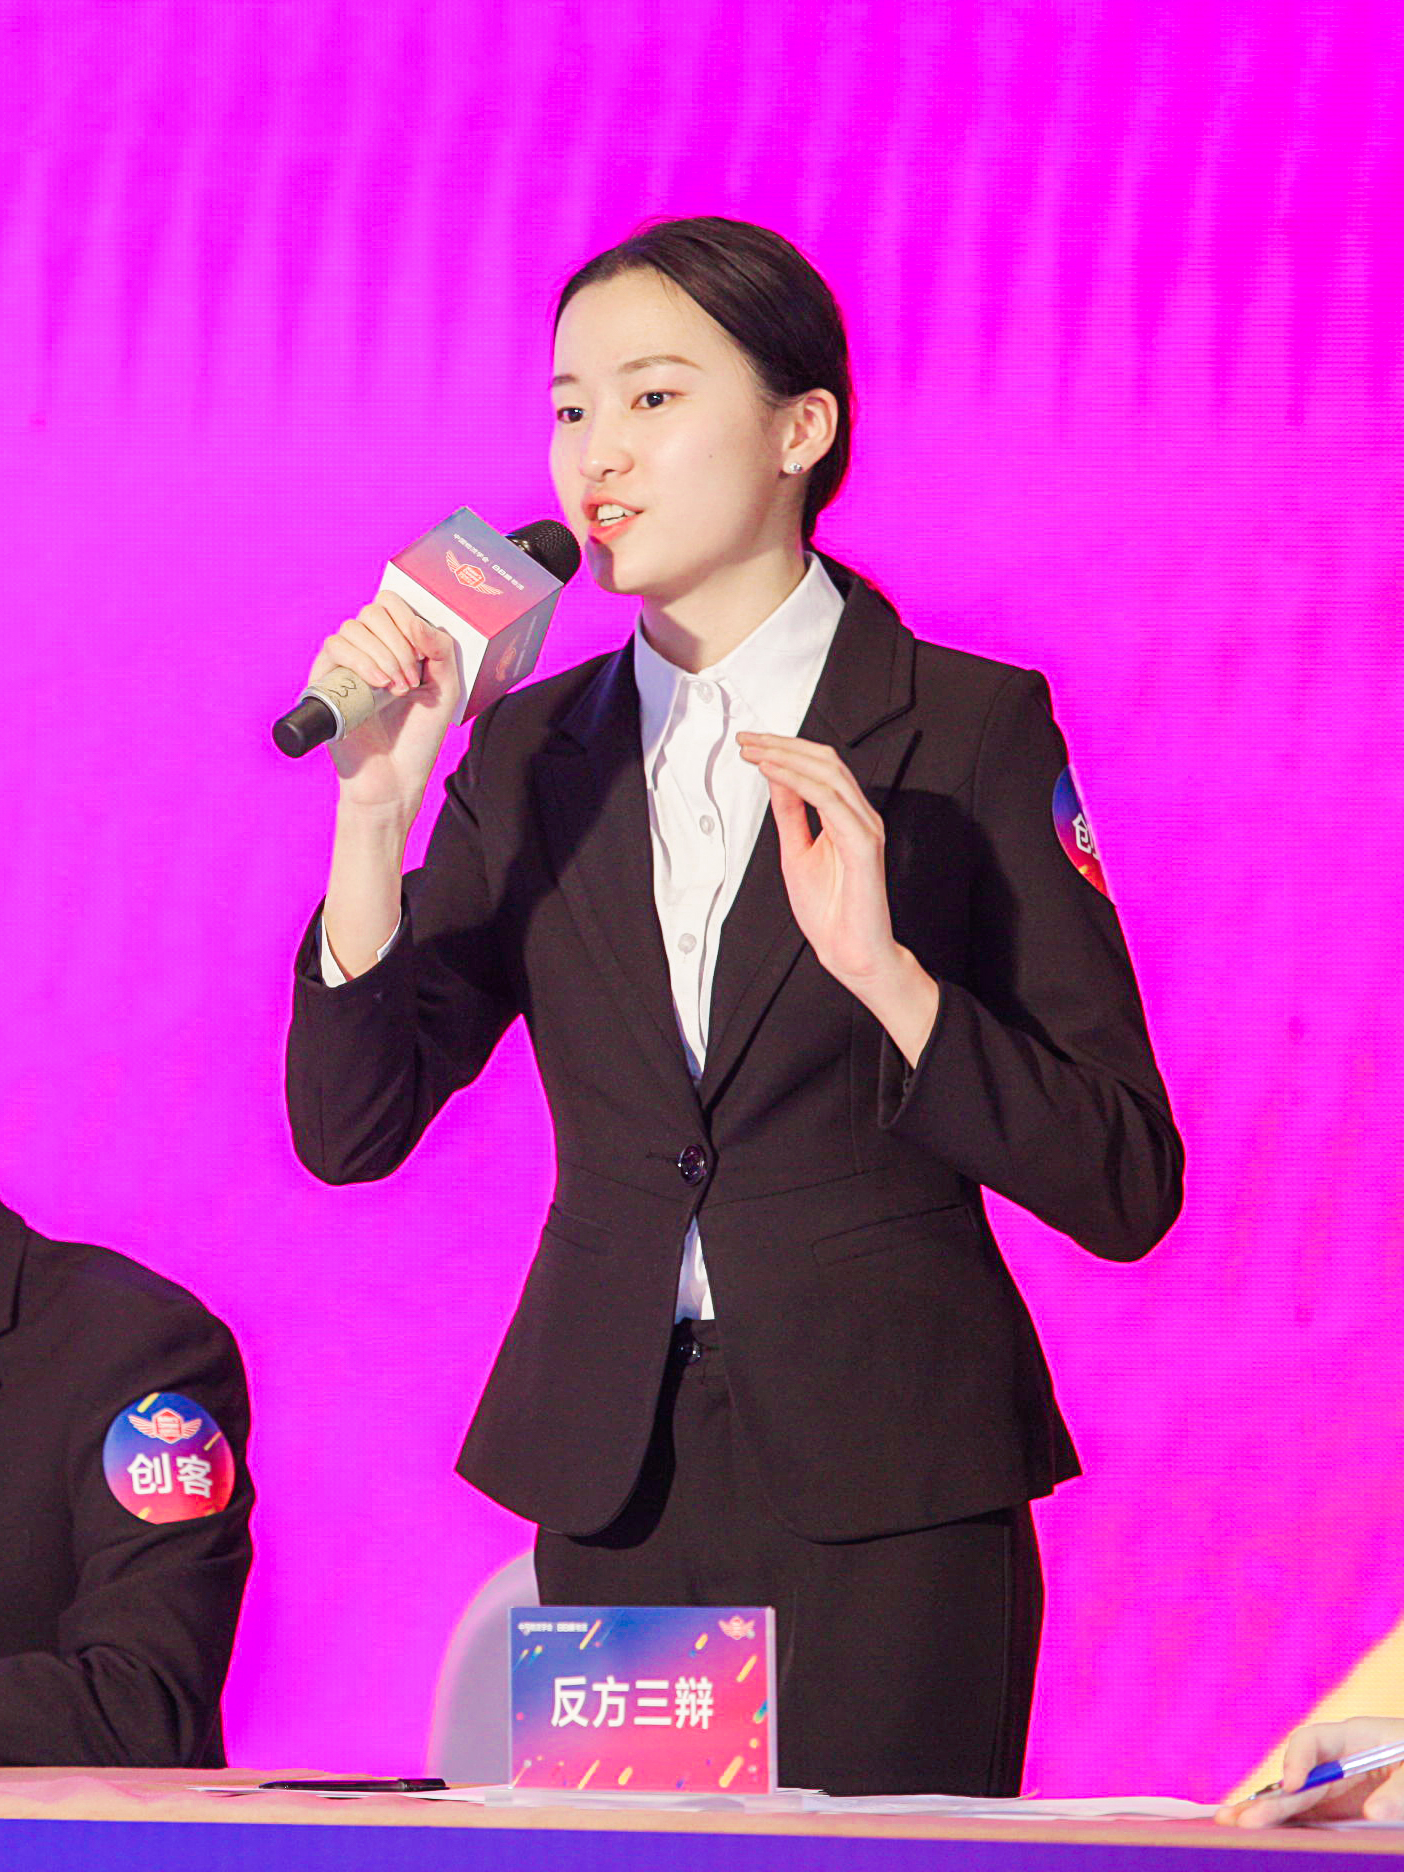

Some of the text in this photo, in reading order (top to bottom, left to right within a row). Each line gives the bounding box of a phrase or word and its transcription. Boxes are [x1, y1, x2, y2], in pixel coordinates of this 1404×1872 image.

[127, 1452, 213, 1499] 创客
[550, 1675, 714, 1730] 反方三辩
